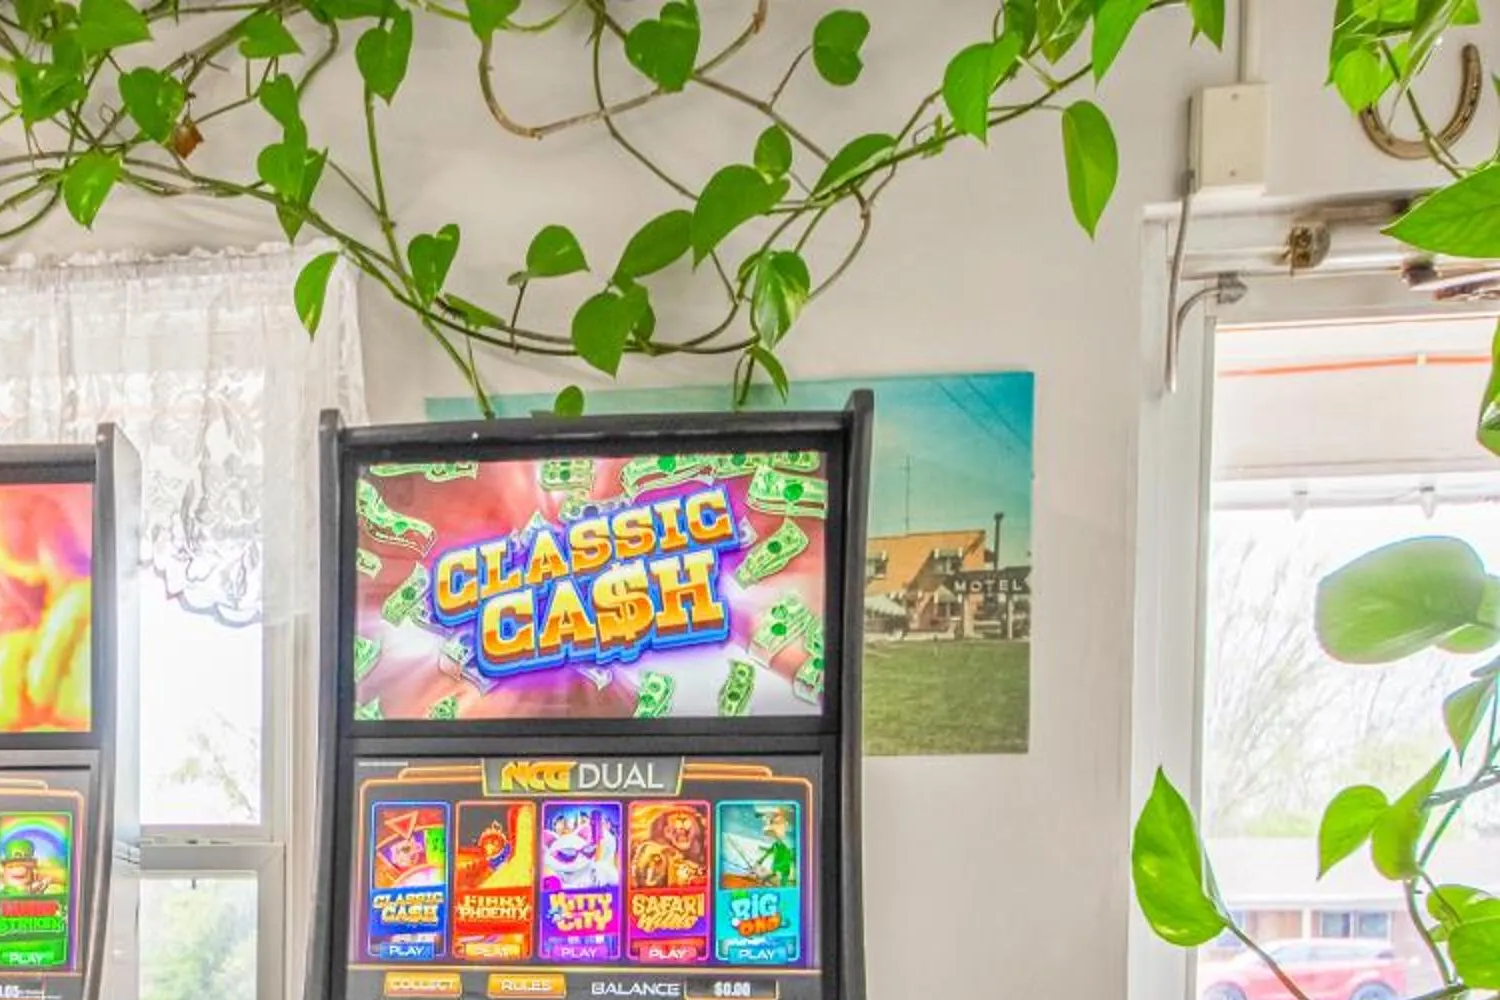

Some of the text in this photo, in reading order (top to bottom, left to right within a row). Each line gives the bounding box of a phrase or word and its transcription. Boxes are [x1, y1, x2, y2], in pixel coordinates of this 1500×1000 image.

[435, 488, 735, 613] CLASSIC
[953, 579, 1022, 593] MOTEL
[480, 551, 726, 666] CA$H
[579, 762, 664, 789] DUAL
[550, 892, 612, 915] KITTY
[632, 893, 704, 916] SAFARI
[731, 893, 778, 920] BIG
[556, 910, 612, 931] CITY
[9, 952, 44, 964] PLAY
[389, 946, 424, 956] PLAY
[561, 947, 597, 959] PLAY
[650, 948, 687, 959] PLAY
[739, 949, 775, 960] PLAY
[500, 980, 552, 992] RULES
[591, 982, 680, 996] BALANCE
[714, 981, 751, 997] $0.00
